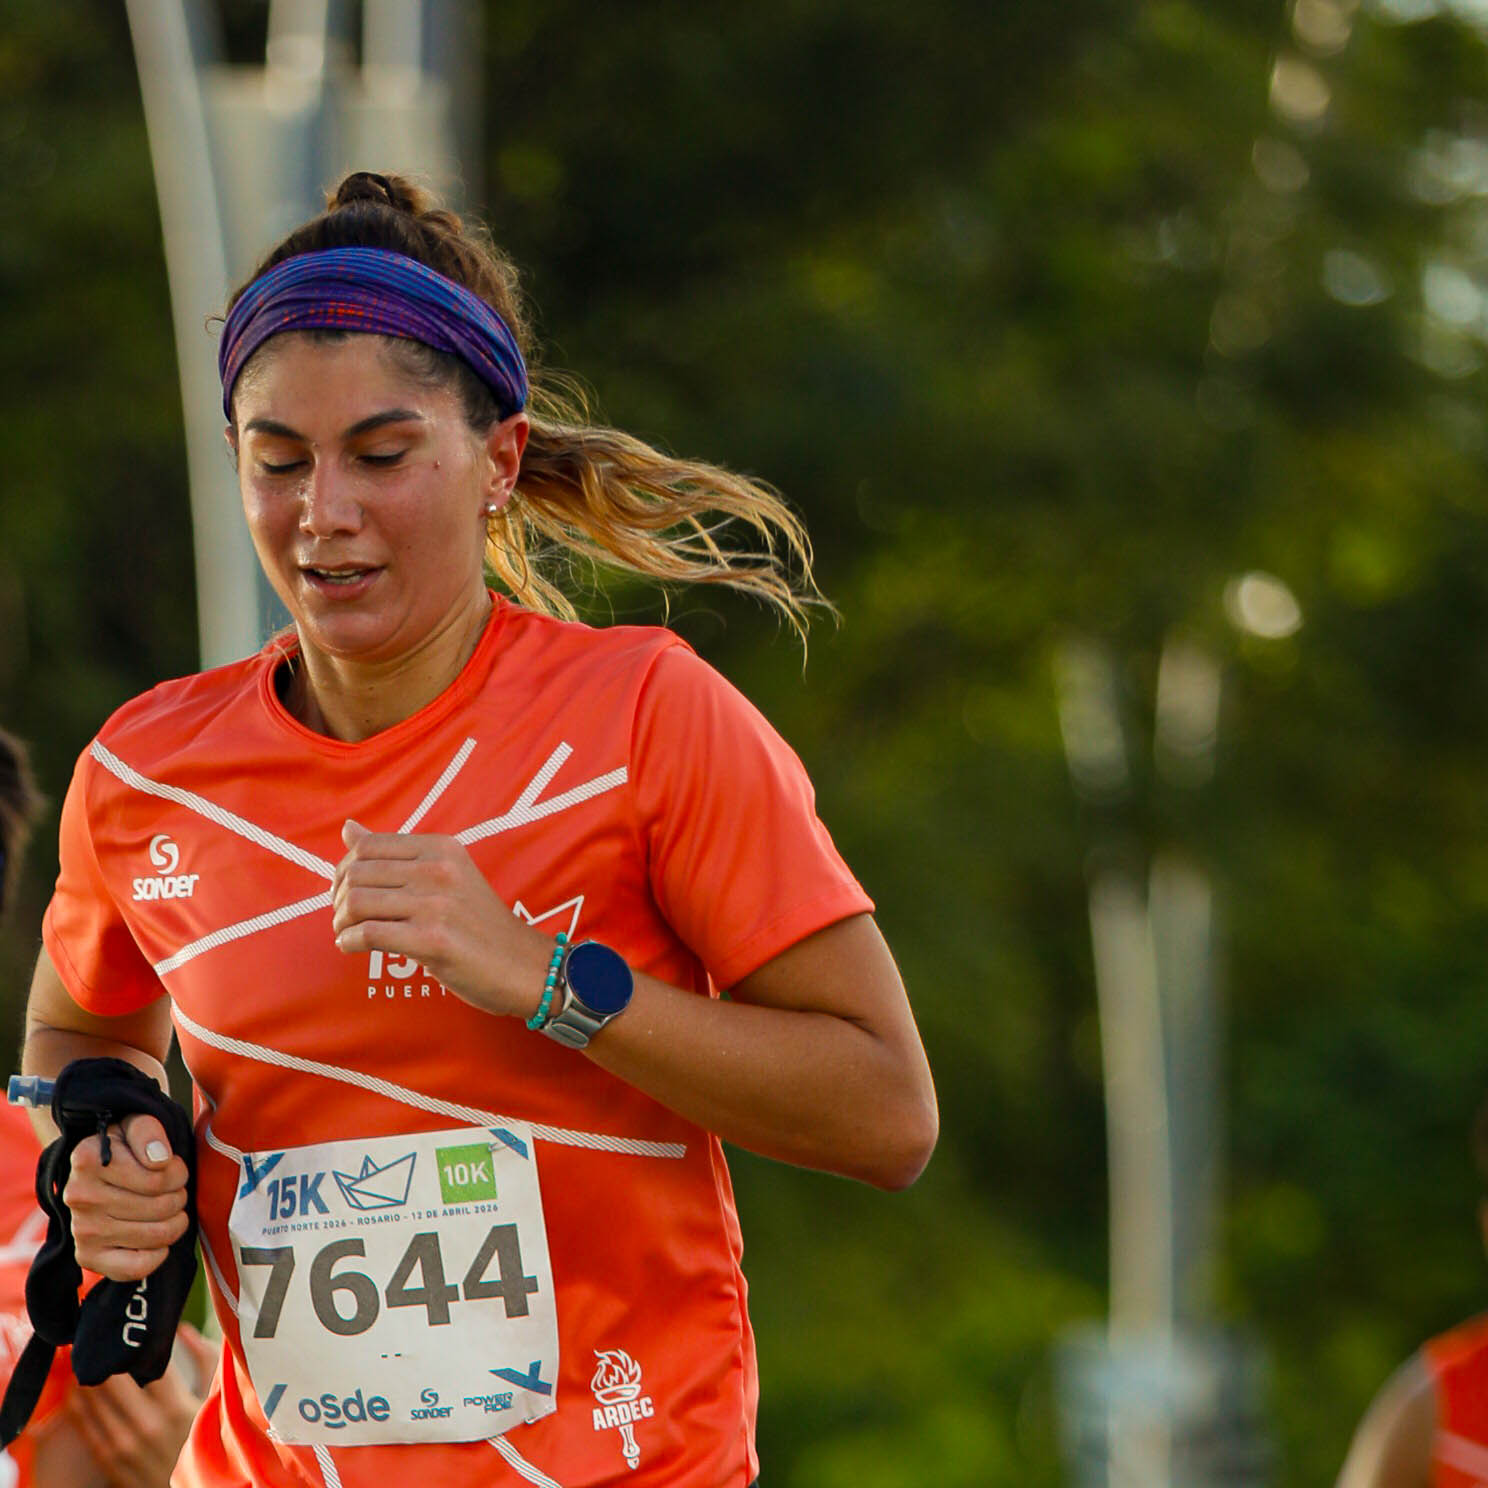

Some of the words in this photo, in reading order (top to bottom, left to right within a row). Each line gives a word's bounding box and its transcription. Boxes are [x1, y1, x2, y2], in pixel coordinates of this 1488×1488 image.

[368, 950, 432, 979] 15
[367, 984, 447, 999] PUERT
[266, 1172, 331, 1221] 15K
[443, 1161, 491, 1188] 10K
[262, 1223, 289, 1236] PUERTO
[290, 1221, 320, 1233] NORTE
[357, 1213, 401, 1226] ROSARIO
[411, 1210, 423, 1221] 12
[426, 1209, 439, 1219] DE
[441, 1207, 472, 1217] ABRIL
[239, 1222, 540, 1340] 7644
[298, 1387, 391, 1425] osde
[592, 1396, 655, 1432] ARDEC
